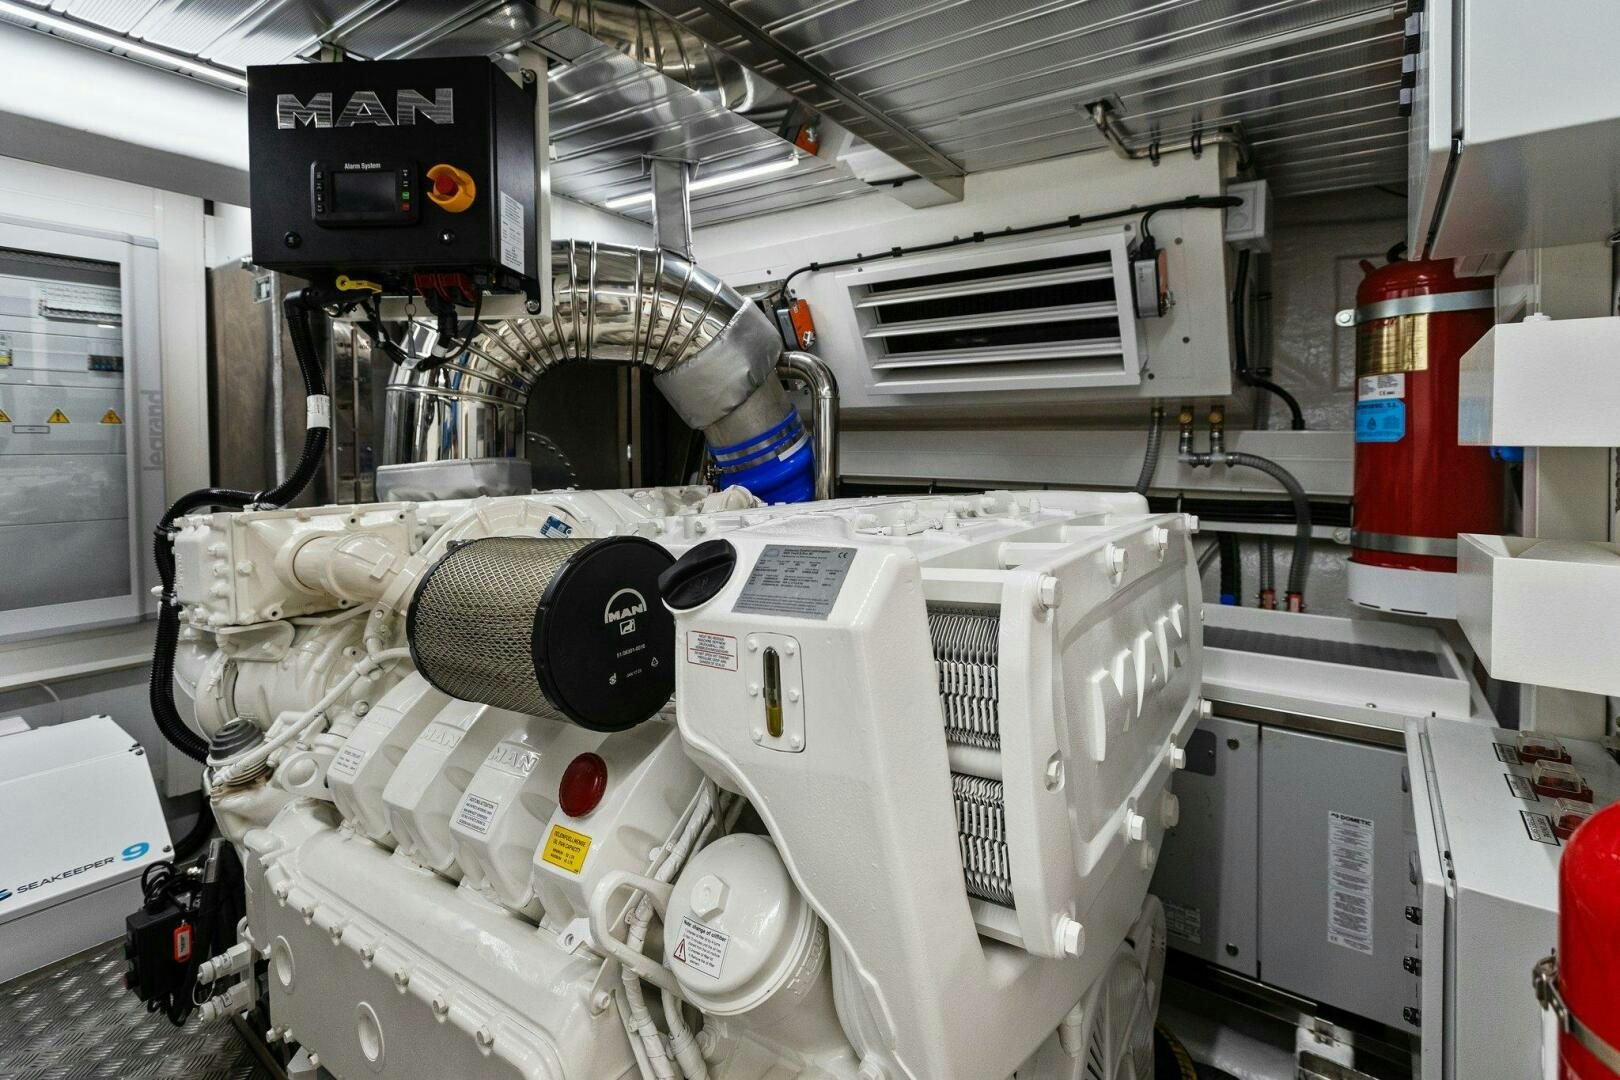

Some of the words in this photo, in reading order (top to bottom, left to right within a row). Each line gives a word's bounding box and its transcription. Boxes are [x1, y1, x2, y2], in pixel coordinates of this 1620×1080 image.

[277, 88, 454, 129] MAN
[361, 162, 381, 170] System
[608, 603, 644, 622] MAN
[488, 747, 541, 776] MAN
[1340, 814, 1372, 827] DOMETIC
[17, 856, 115, 893] SEAKEEPER
[121, 842, 149, 861] 9
